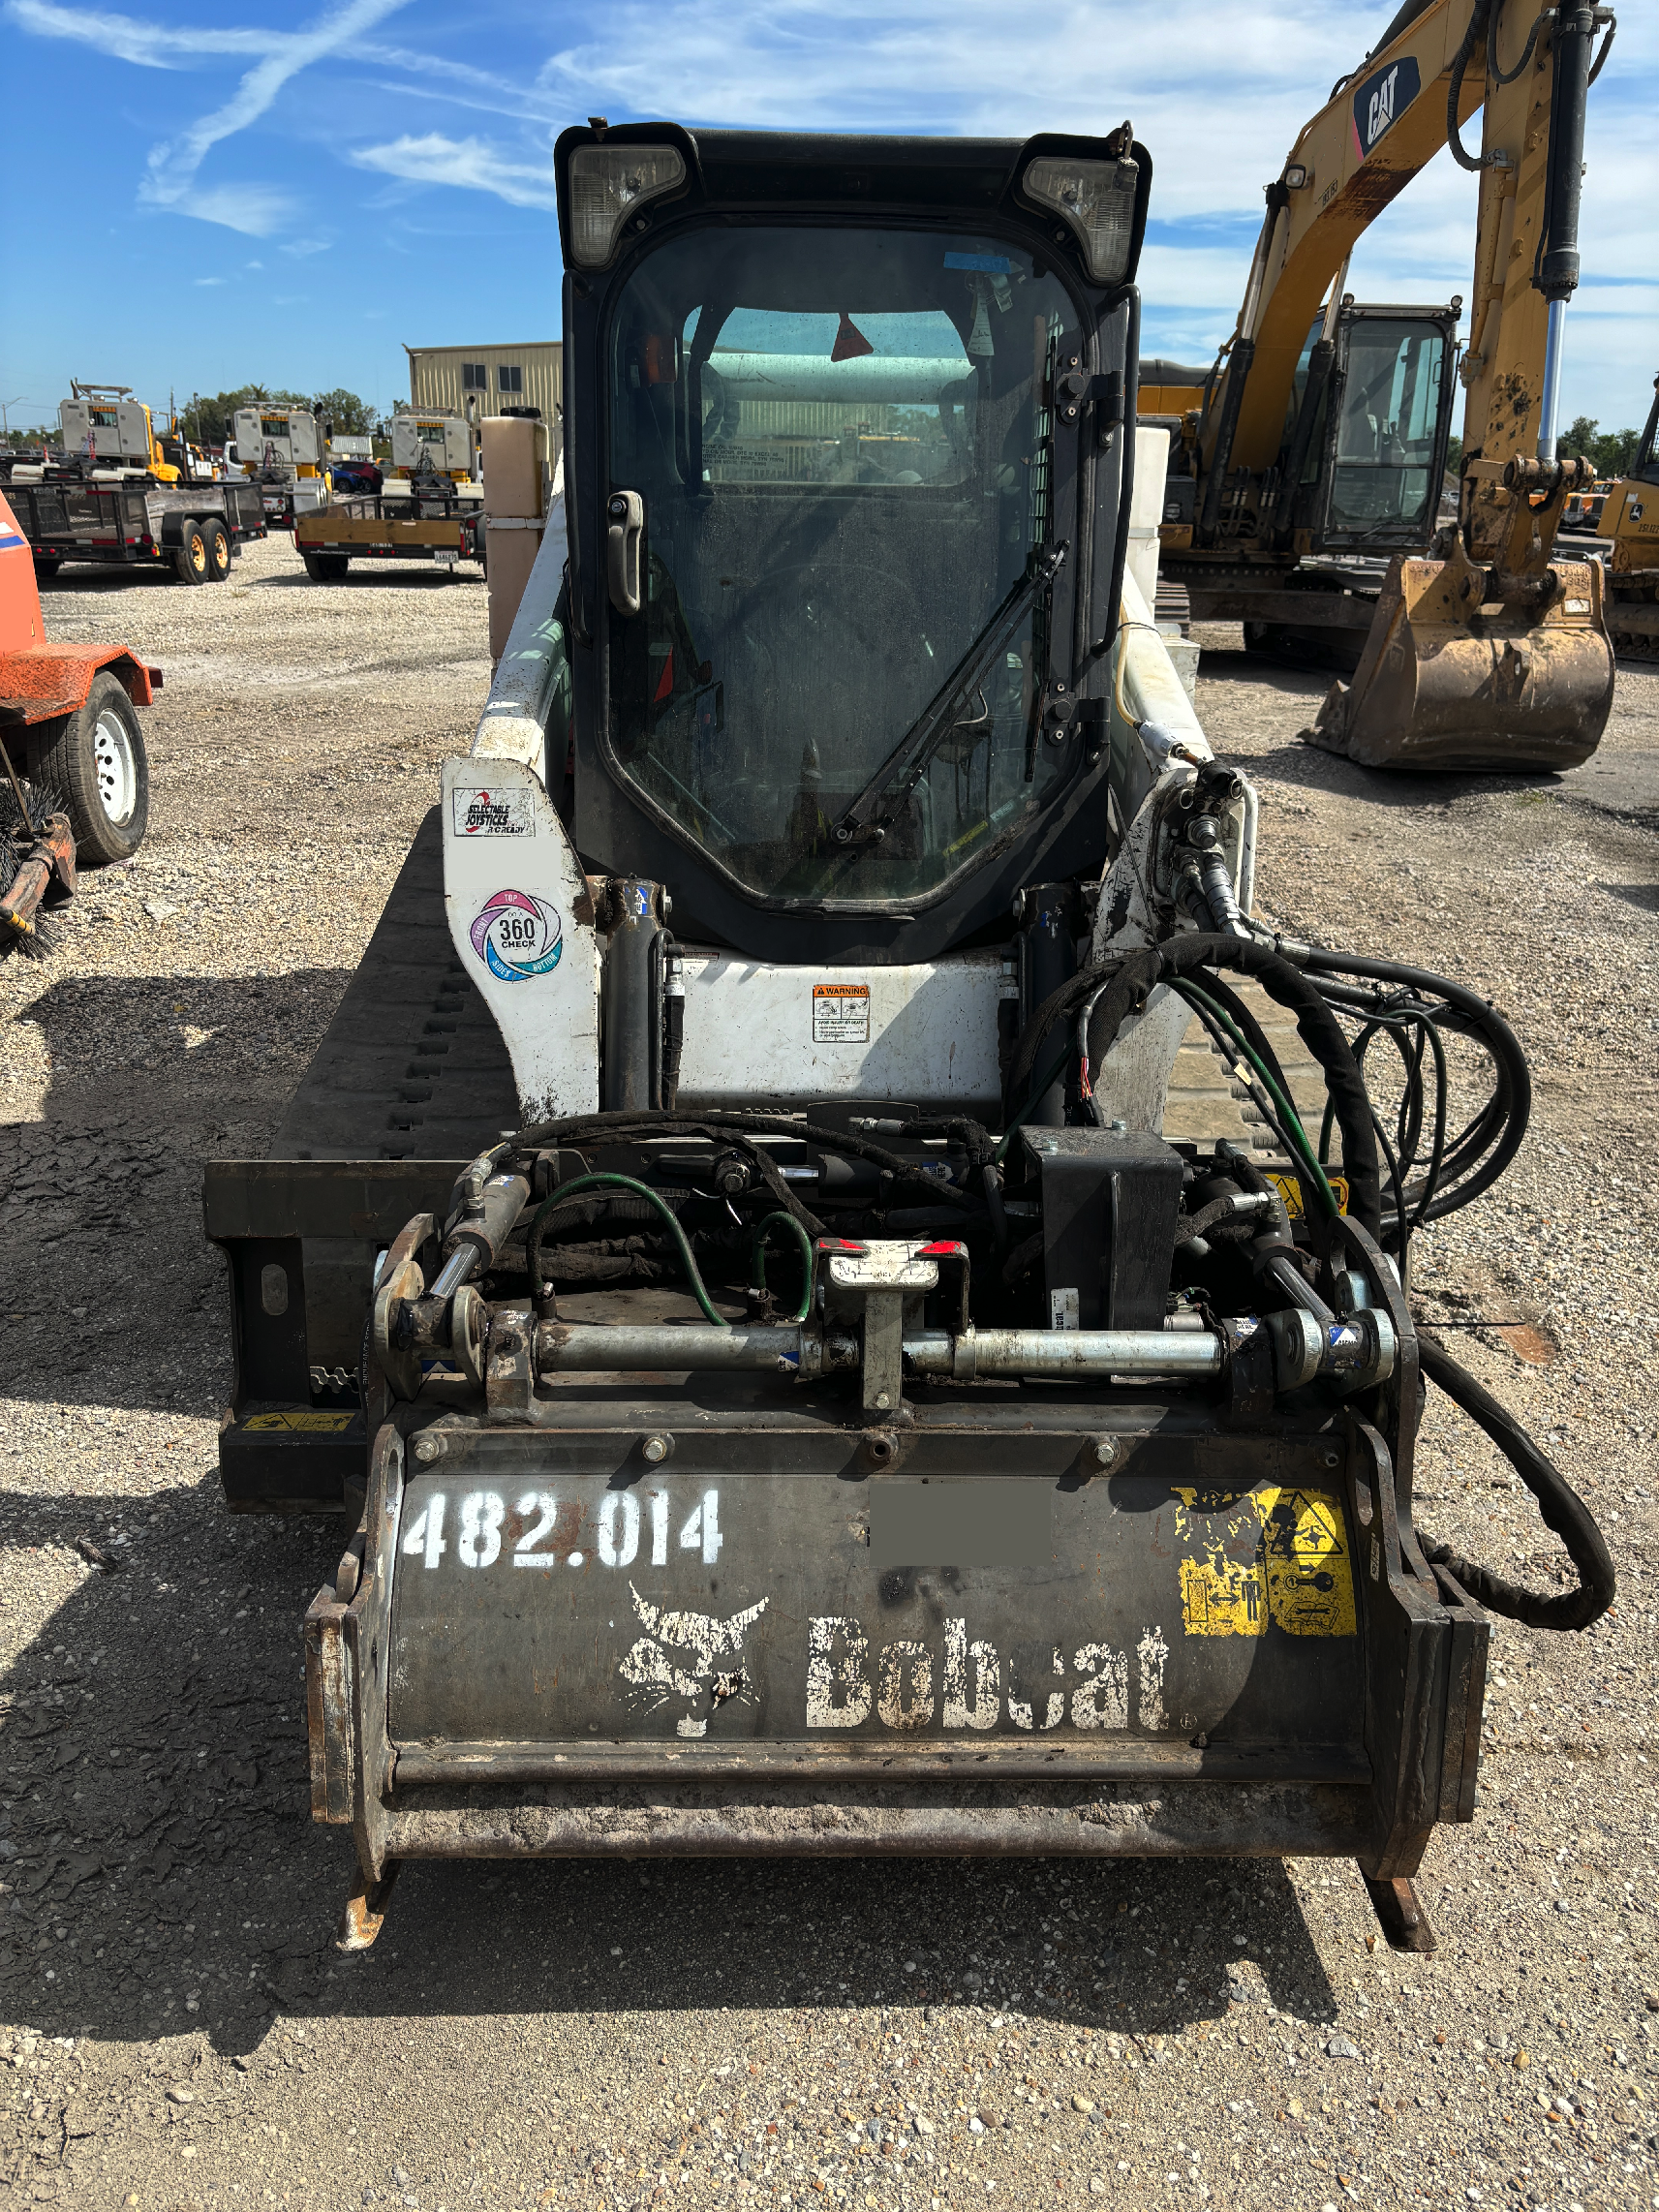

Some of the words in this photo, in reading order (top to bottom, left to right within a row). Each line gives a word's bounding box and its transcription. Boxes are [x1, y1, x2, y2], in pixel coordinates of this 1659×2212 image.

[1367, 65, 1398, 145] CAT
[467, 804, 510, 814] SELECTABLE
[465, 814, 509, 826] JOYSTICKS
[504, 894, 518, 903] TOP
[473, 916, 489, 940] FRONT
[499, 917, 536, 940] 360
[501, 939, 537, 949] CHECK
[491, 960, 511, 978] SIDES
[402, 1490, 723, 1570] 482.014
[806, 1616, 1170, 1731] Bobcat
